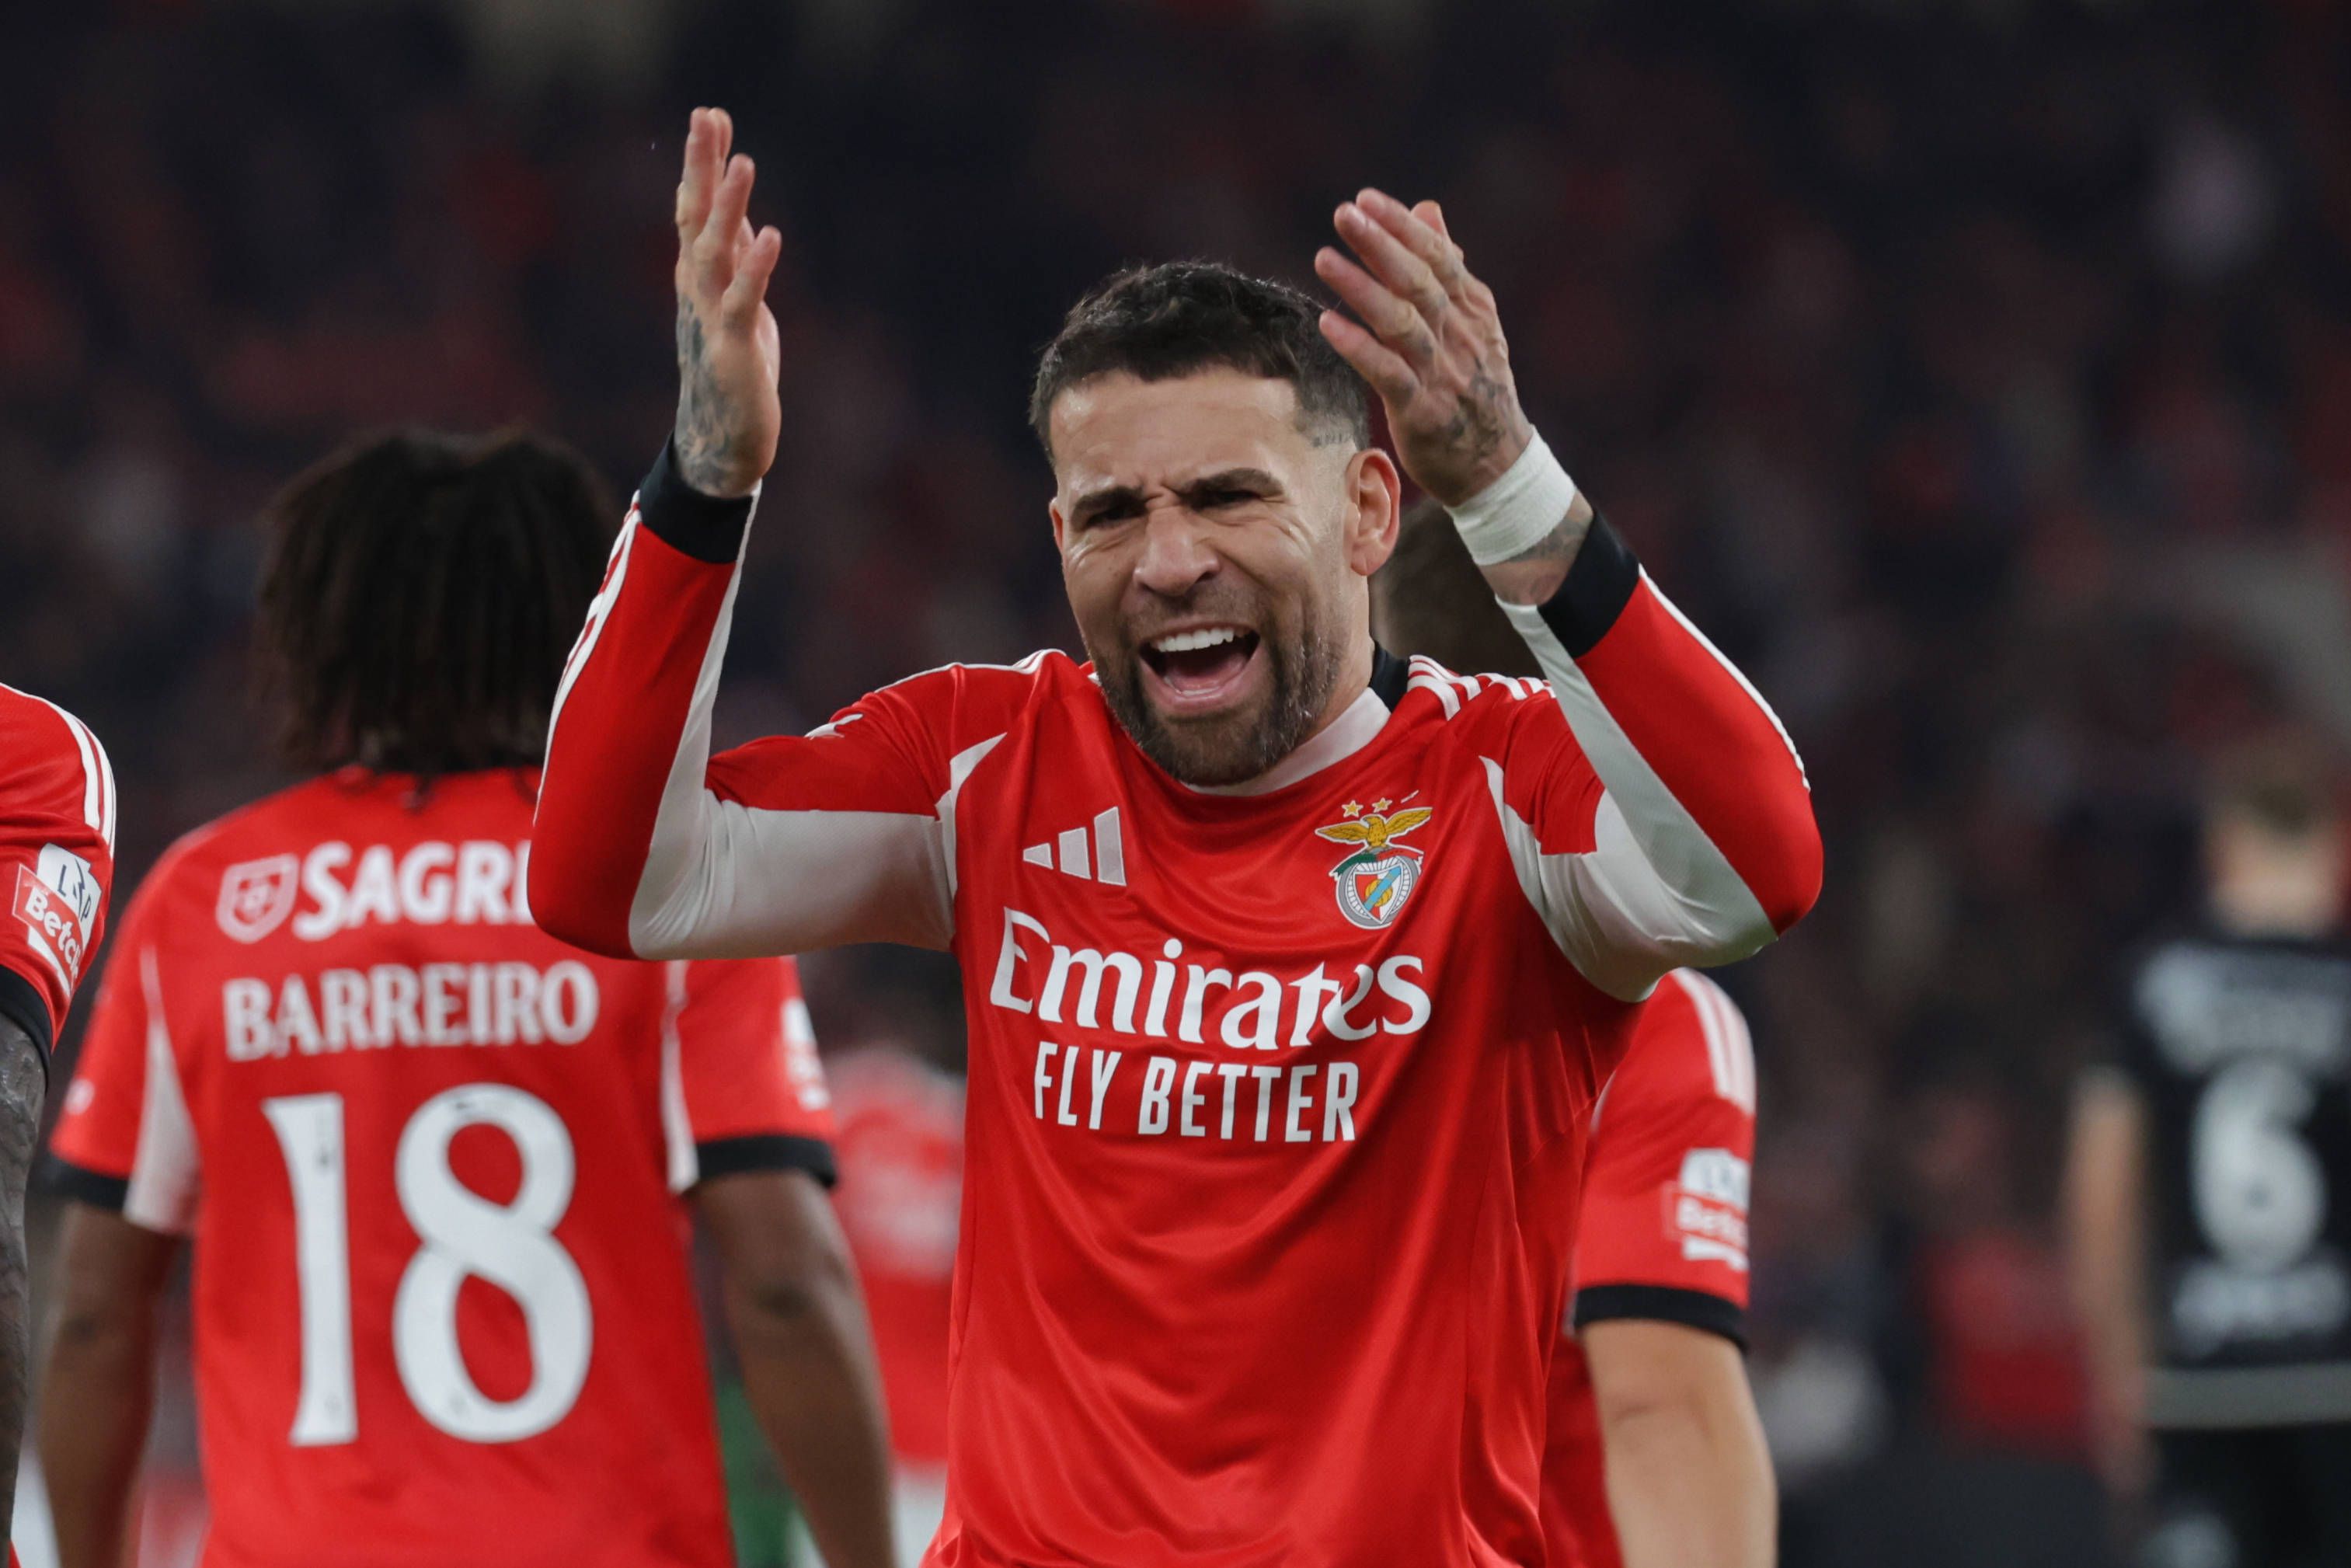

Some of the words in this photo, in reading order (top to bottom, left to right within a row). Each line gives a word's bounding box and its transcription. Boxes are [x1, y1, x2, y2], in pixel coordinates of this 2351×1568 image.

[222, 960, 599, 1061] BARREIRO
[990, 907, 1431, 1051] Emirates
[1034, 1041, 1122, 1130] FLY
[1137, 1056, 1359, 1143] BETTER
[2189, 1055, 2325, 1269] 6
[260, 1082, 594, 1448] 18
